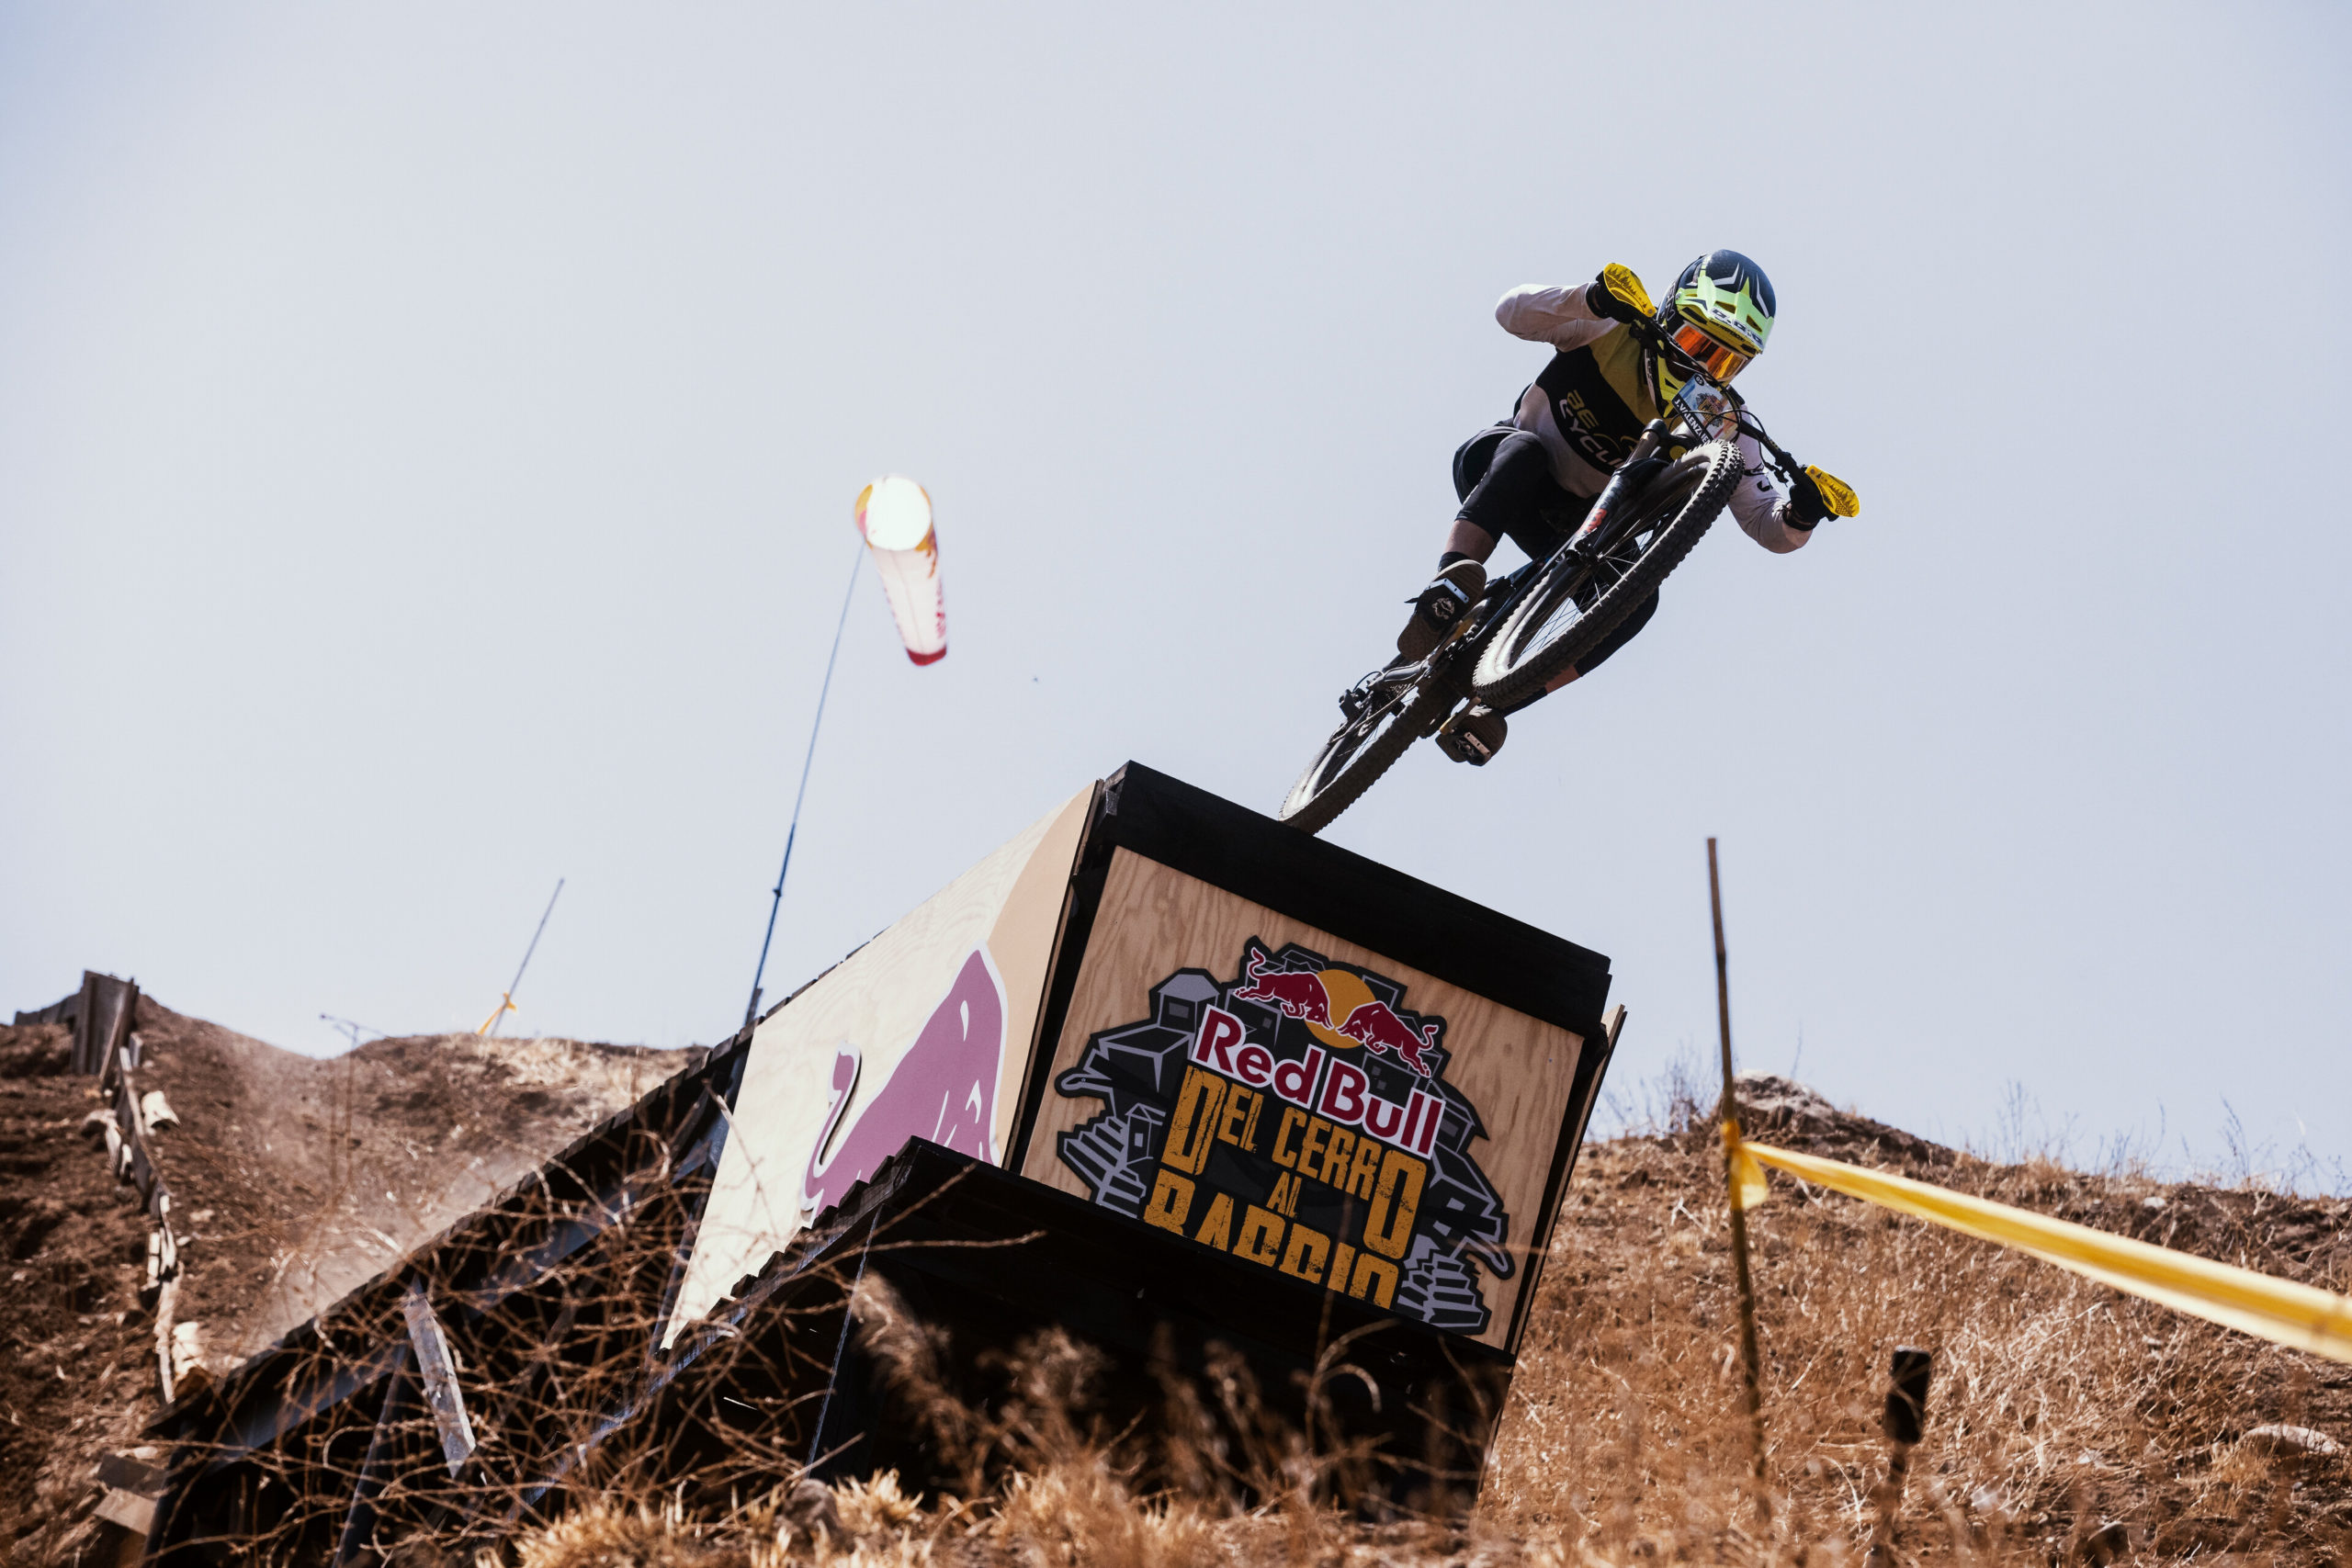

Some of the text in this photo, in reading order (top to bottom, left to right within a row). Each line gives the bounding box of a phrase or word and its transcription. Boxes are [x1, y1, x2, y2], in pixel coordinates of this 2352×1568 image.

[1161, 1065, 1428, 1259] DEL CERRO
[1266, 1171, 1303, 1219] AL
